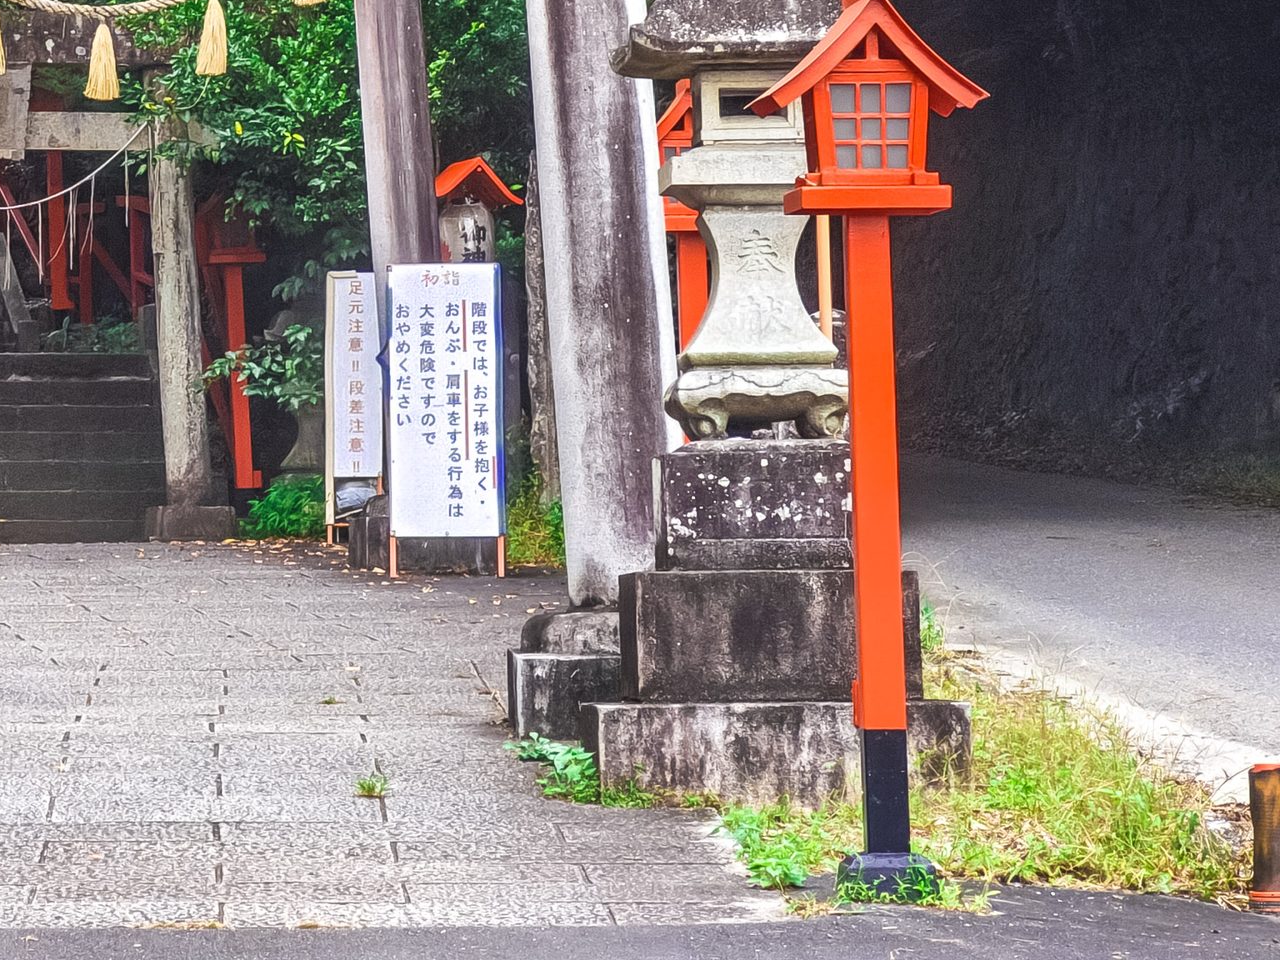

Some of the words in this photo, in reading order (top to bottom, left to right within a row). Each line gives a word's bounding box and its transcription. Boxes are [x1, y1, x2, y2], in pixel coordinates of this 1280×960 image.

[421, 270, 460, 287] 初詣
[395, 305, 412, 427] おやめください
[419, 304, 437, 446] 大変危険ですので
